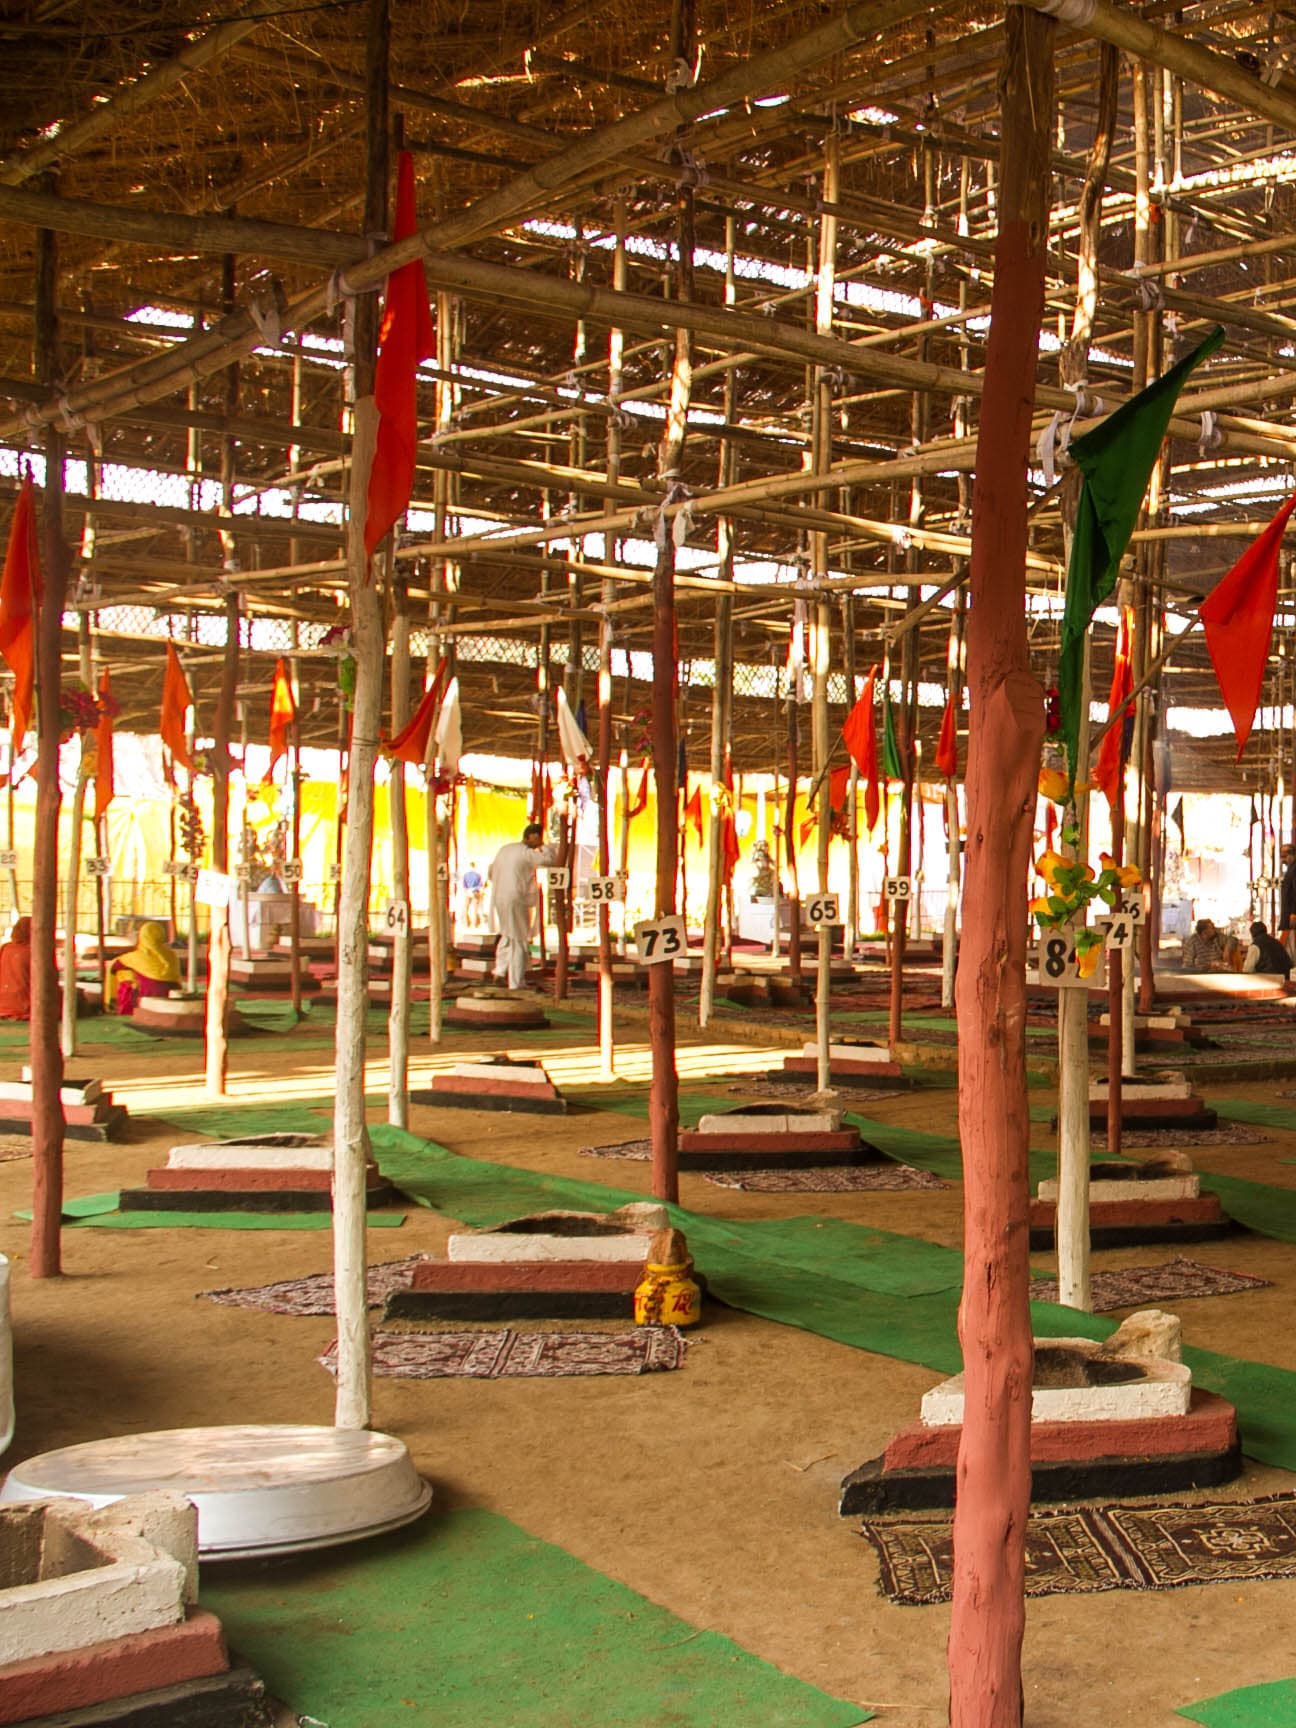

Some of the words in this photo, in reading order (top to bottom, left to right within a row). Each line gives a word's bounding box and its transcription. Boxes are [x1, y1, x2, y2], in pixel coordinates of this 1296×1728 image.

[550, 873, 564, 886] 51
[887, 881, 909, 896] 59
[591, 882, 614, 899] 58
[387, 906, 405, 931] 64
[810, 900, 836, 921] 65
[641, 928, 681, 956] 73
